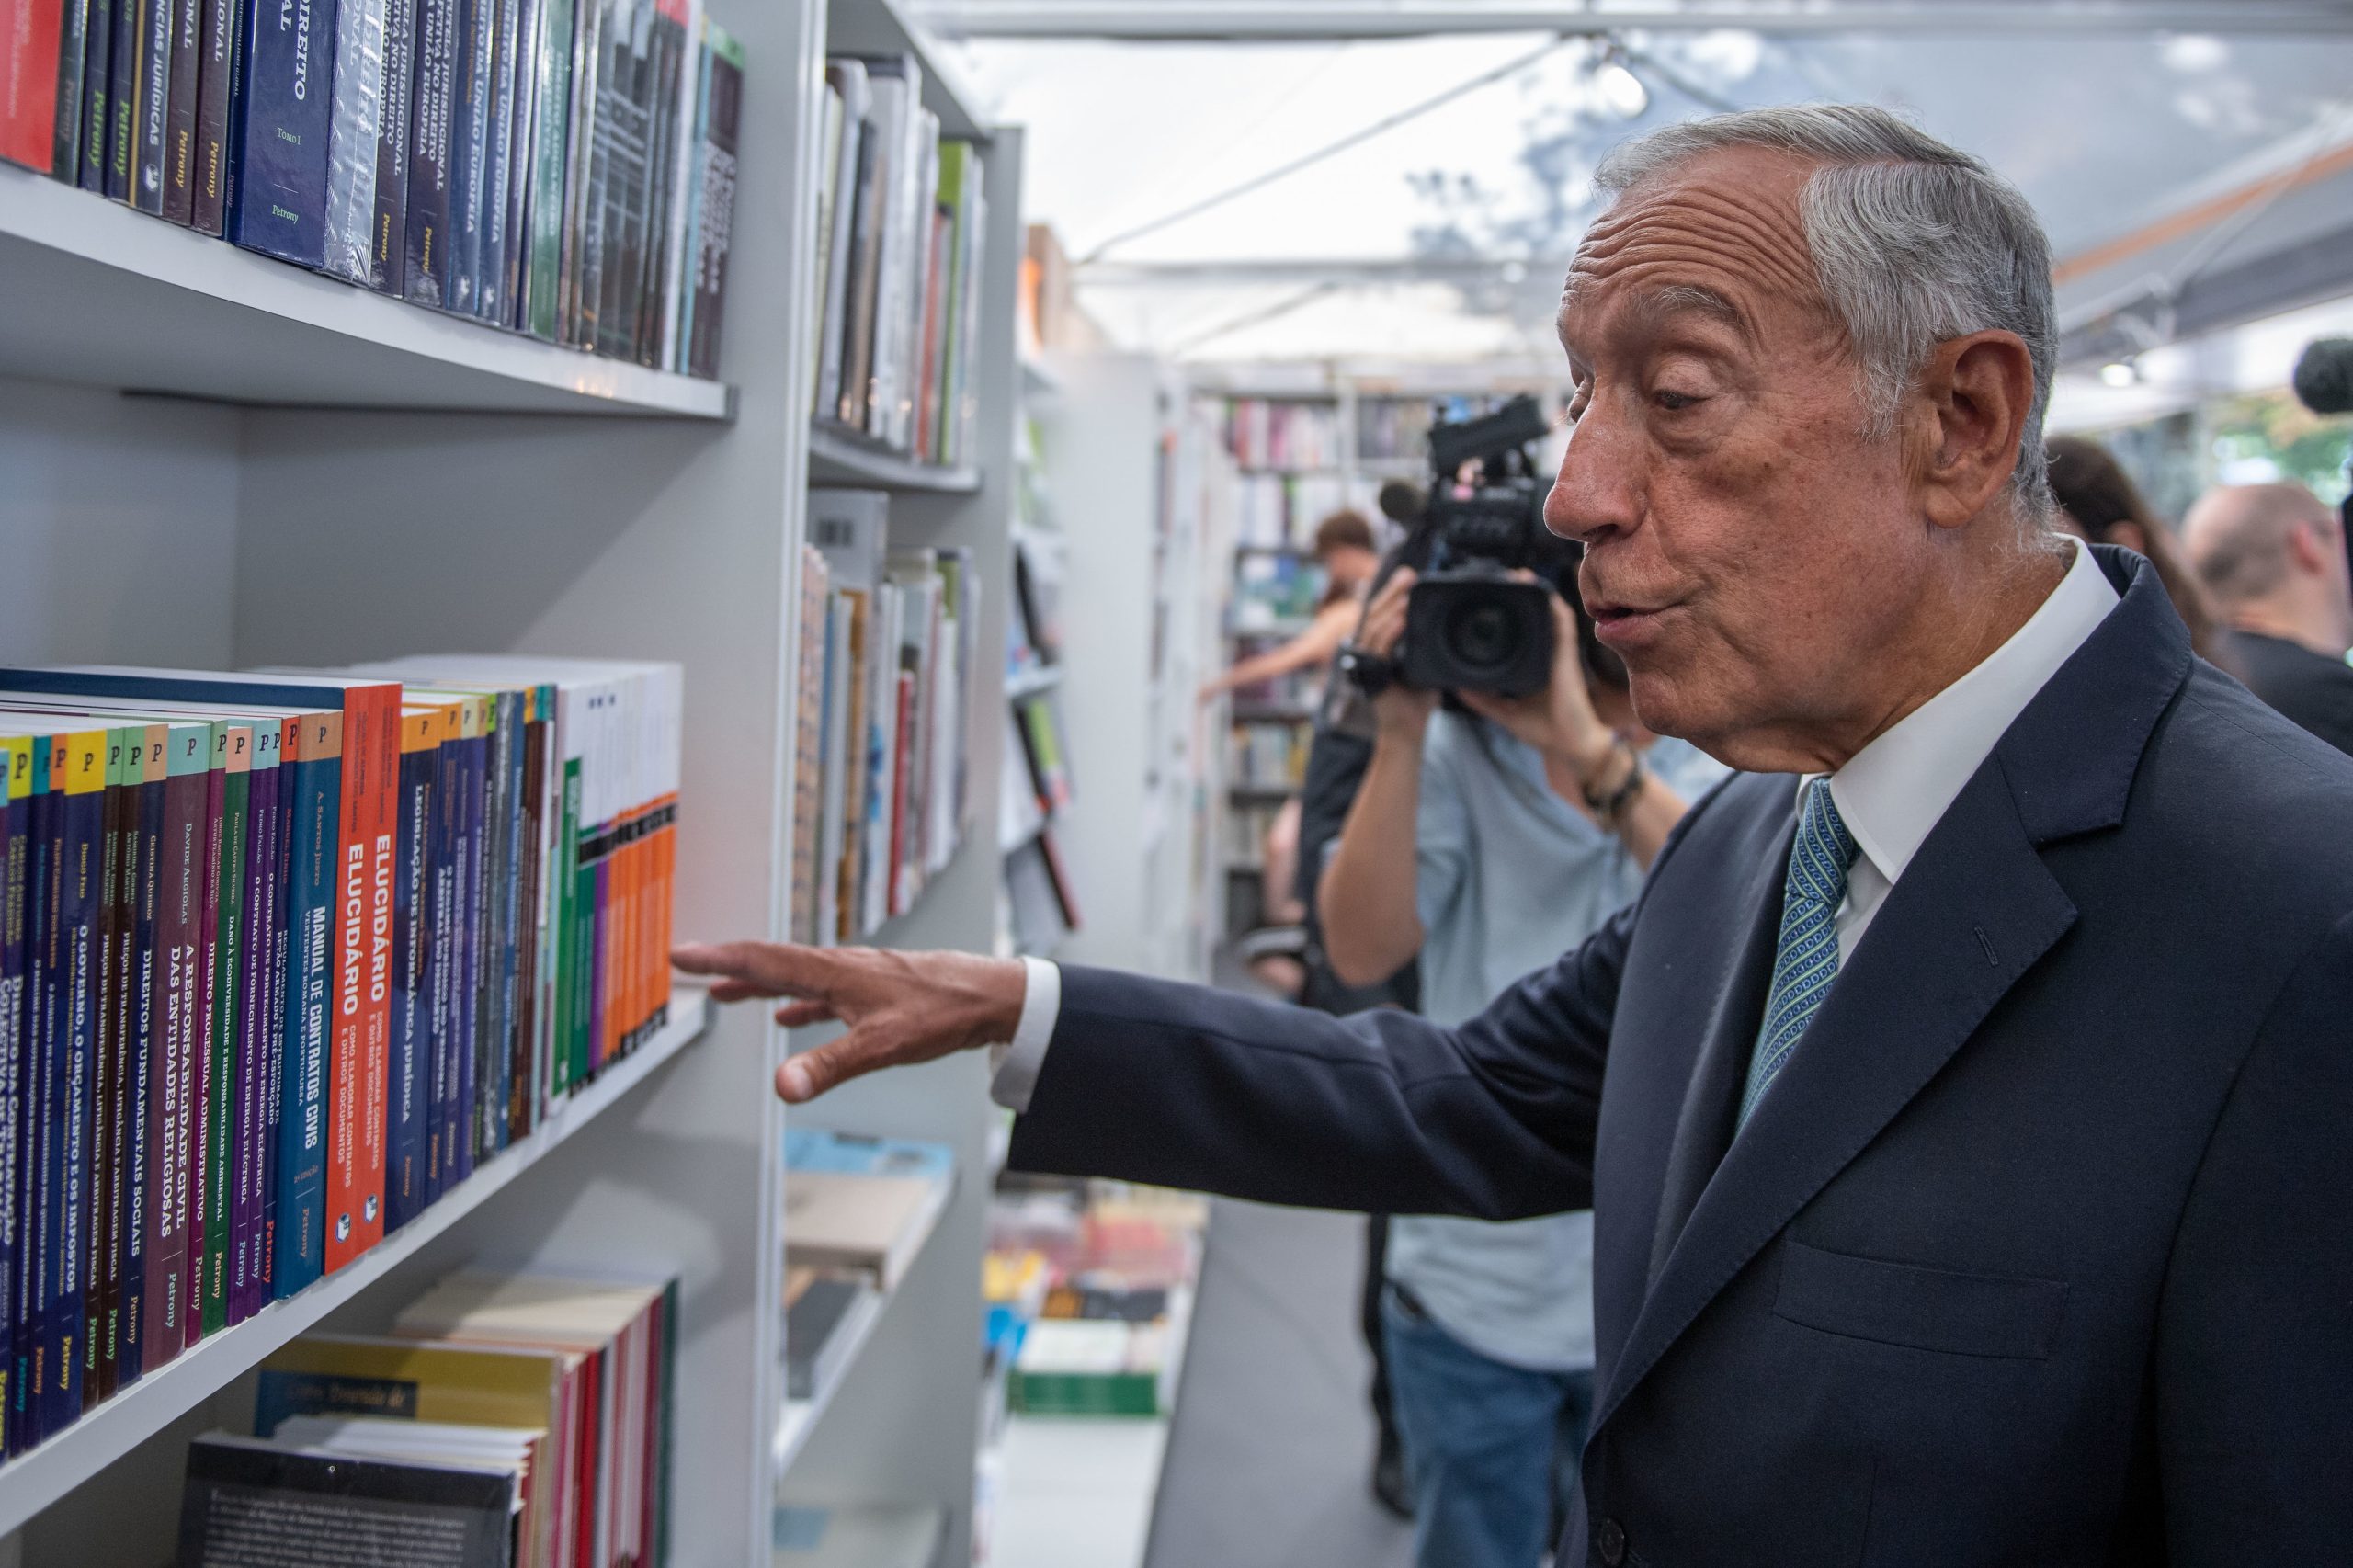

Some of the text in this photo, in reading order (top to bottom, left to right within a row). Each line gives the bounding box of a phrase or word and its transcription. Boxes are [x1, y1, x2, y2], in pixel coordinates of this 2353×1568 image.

[149, 53, 164, 145] JURÍDICAS
[377, 51, 388, 139] EUROPEIA
[386, 43, 399, 145] NO DIREITO
[395, 42, 408, 176] JURISDICIONAL
[419, 12, 435, 156] UNIÃO EUROPEIA
[428, 63, 439, 161] NO DIREITO
[89, 89, 105, 167] Petrony
[114, 101, 130, 176] Petrony
[175, 129, 188, 188] Petrony
[437, 62, 449, 191] JURISDICIONAL
[466, 51, 484, 233] DA UNIÃO EUROPEIA
[492, 67, 509, 243] DA UNIÃO EUROPEIA
[206, 141, 219, 199] Petrony
[272, 204, 299, 224] Petrony
[381, 213, 391, 261] Petrony
[423, 226, 432, 273] Petrony
[284, 807, 292, 849] MANUEL
[315, 805, 324, 850] SANTOS
[317, 791, 324, 803] A.
[146, 881, 154, 921] QUEIROZ
[182, 824, 193, 925] DAVIDE ARGIOLAS
[266, 884, 274, 947] CONTRATO
[344, 843, 364, 1015] ELUCIDÁRIO
[369, 835, 391, 1002] ELUCIDÁRIO
[100, 934, 109, 975] PREÇOS
[120, 932, 130, 974] PREÇOS
[121, 976, 129, 991] DE
[251, 954, 257, 969] DE
[265, 949, 271, 964] DE
[278, 930, 288, 1015] REGULAMENTO
[403, 785, 423, 1125] LEGISLAÇÃO DE INFORMÁTICA JURÍDICA
[101, 979, 108, 993] DE
[223, 958, 233, 1046] ECODIVERSIDADE
[246, 971, 256, 1065] FORNECIMENTO
[261, 967, 270, 1059] FORNECIMENTO
[96, 995, 108, 1093] TRANSFERÊNCIA,
[117, 992, 128, 1088] TRANSFERÊNCIA,
[278, 1017, 284, 1028] DE
[305, 906, 325, 1149] MANUAL DE CONTRATOS CIVIS
[162, 947, 181, 1237] DAS ENTIDADES RELIGIOSAS
[176, 943, 194, 1229] A RESPONSABILIDADE CIVIL
[197, 941, 215, 1221] DIREITO PROCESSUAL ADMINISTRATIVO
[245, 1068, 252, 1083] DE
[260, 1061, 267, 1077] DE
[267, 1033, 278, 1125] PRÉ-ESFORÇADO
[298, 1034, 306, 1107] PORTUGUESA
[347, 1060, 356, 1119] ELABORAR
[373, 1045, 382, 1103] ELABORAR
[2, 975, 23, 1246] DIREITO DA CONTRATAÇÃO
[66, 925, 88, 1292] O GOVERNO, O ORÇAMENTO E OS IMPOSTOS
[95, 1094, 104, 1160] LITIGÂNCIA
[114, 1090, 124, 1154] LITIGÂNCIA
[131, 950, 152, 1256] DIREITOS FUNDAMENTAIS SOCIAIS
[220, 1057, 228, 1158] RESPONSABILIDADE
[244, 1085, 252, 1138] ENERGIA
[338, 1087, 347, 1164] DOCUMENTOS
[365, 1072, 374, 1146] DOCUMENTOS
[256, 1133, 266, 1197] ELÉCTRICA
[345, 1123, 354, 1187] CONTRATOS
[371, 1106, 381, 1169] CONTRATOS
[110, 1167, 120, 1240] ARBITRAGEM
[241, 1141, 250, 1204] ELÉCTRICA
[91, 1173, 100, 1248] ARBITRAGEM
[300, 1208, 310, 1257] Petrony
[191, 1256, 202, 1311] Petrony
[212, 1252, 222, 1298] Petrony
[236, 1241, 246, 1287] Petrony
[252, 1233, 261, 1278] Petrony
[263, 1221, 274, 1283] Petrony
[127, 1296, 139, 1344] Petrony
[165, 1272, 176, 1327] Petrony
[60, 1335, 72, 1390] Petrony
[85, 1318, 97, 1369] Petrony
[106, 1309, 118, 1360] Petrony
[17, 1357, 28, 1412] Petrony
[33, 1346, 44, 1393] Petrony
